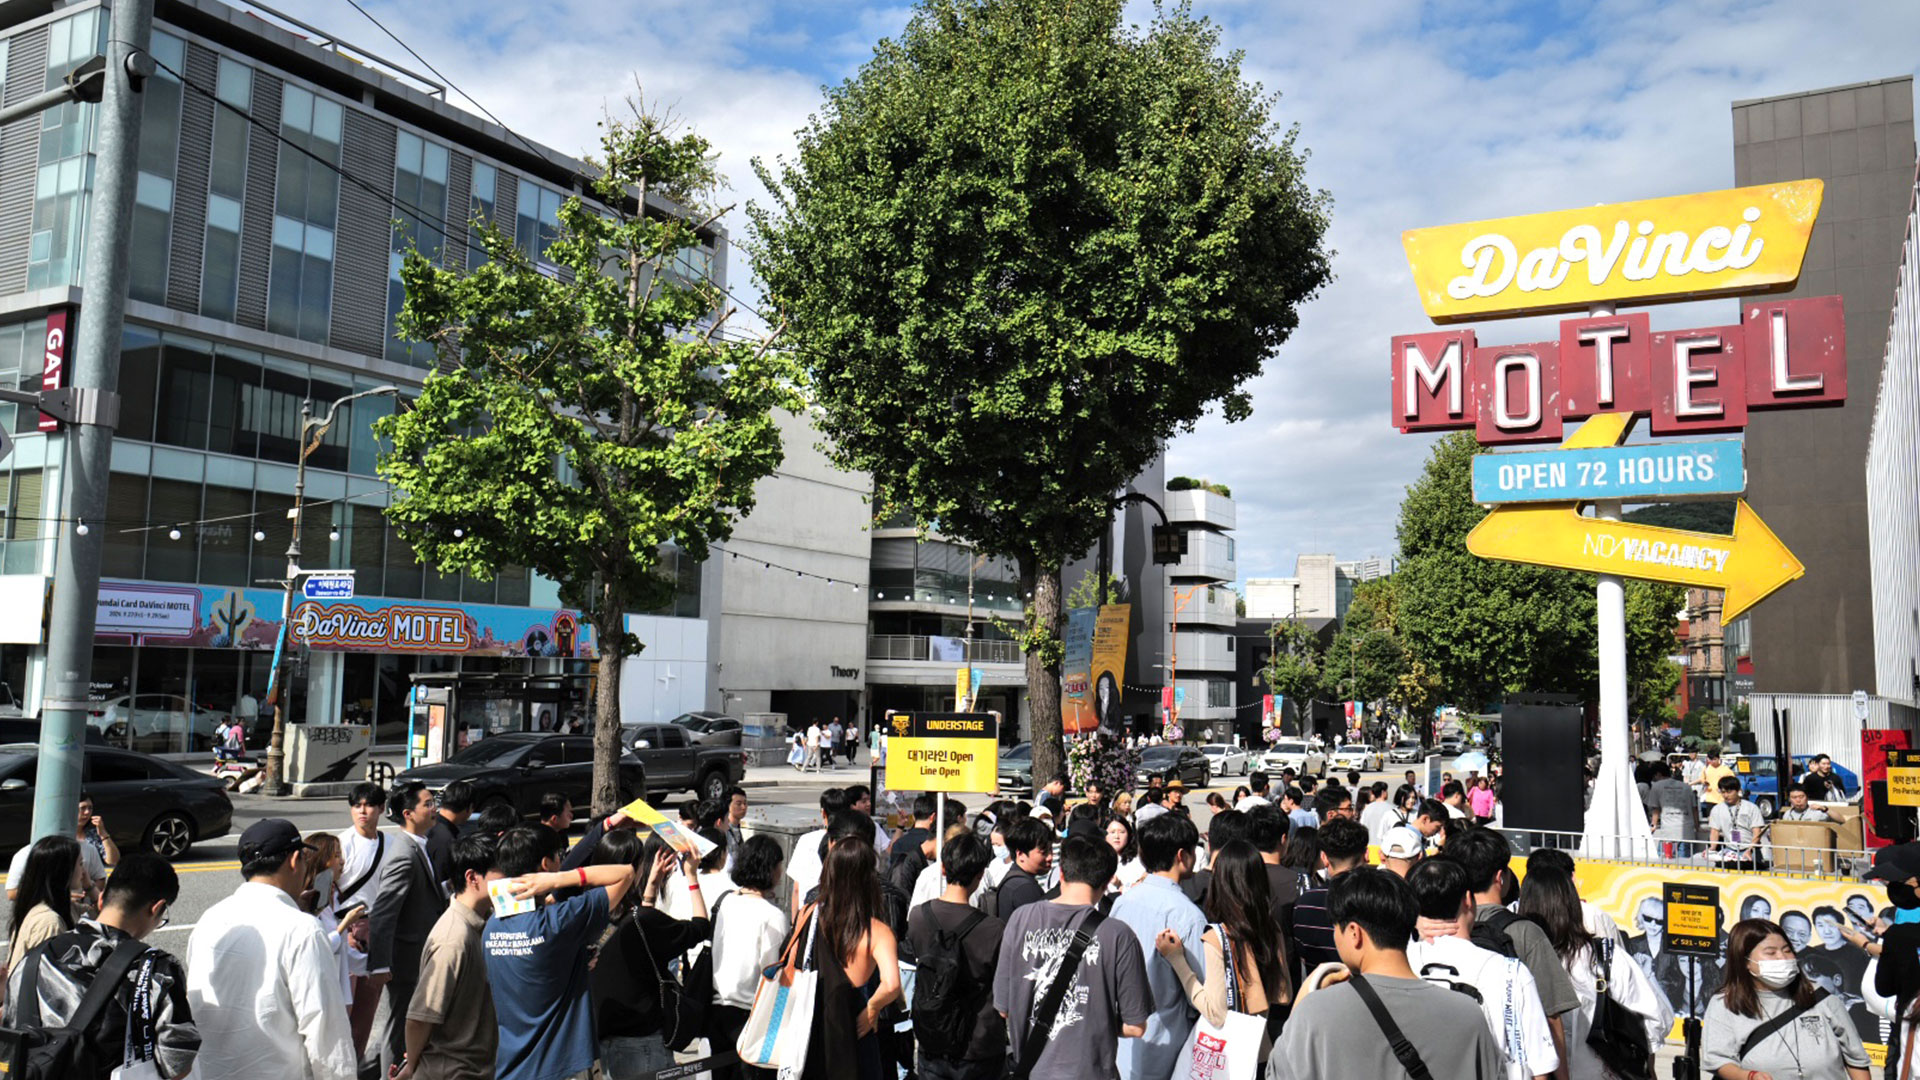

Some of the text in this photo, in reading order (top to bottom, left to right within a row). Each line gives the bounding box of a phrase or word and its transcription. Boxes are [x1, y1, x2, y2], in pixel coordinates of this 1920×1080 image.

[1447, 207, 1764, 299] DaVinci
[44, 328, 63, 390] GAT
[1402, 307, 1824, 429] MOTEL
[1498, 454, 1715, 490] OPEN 72 HOURS
[1621, 537, 1730, 573] VACANCY
[121, 599, 138, 608] Card
[139, 600, 166, 610] DaVinci
[166, 602, 191, 611] MOTEL
[296, 610, 465, 643] DaVinci MOTEL
[830, 665, 860, 680] Theory
[926, 720, 984, 731] UNDERSTAGE
[907, 750, 974, 764] 대기라인 Open
[920, 766, 961, 778] Line Open
